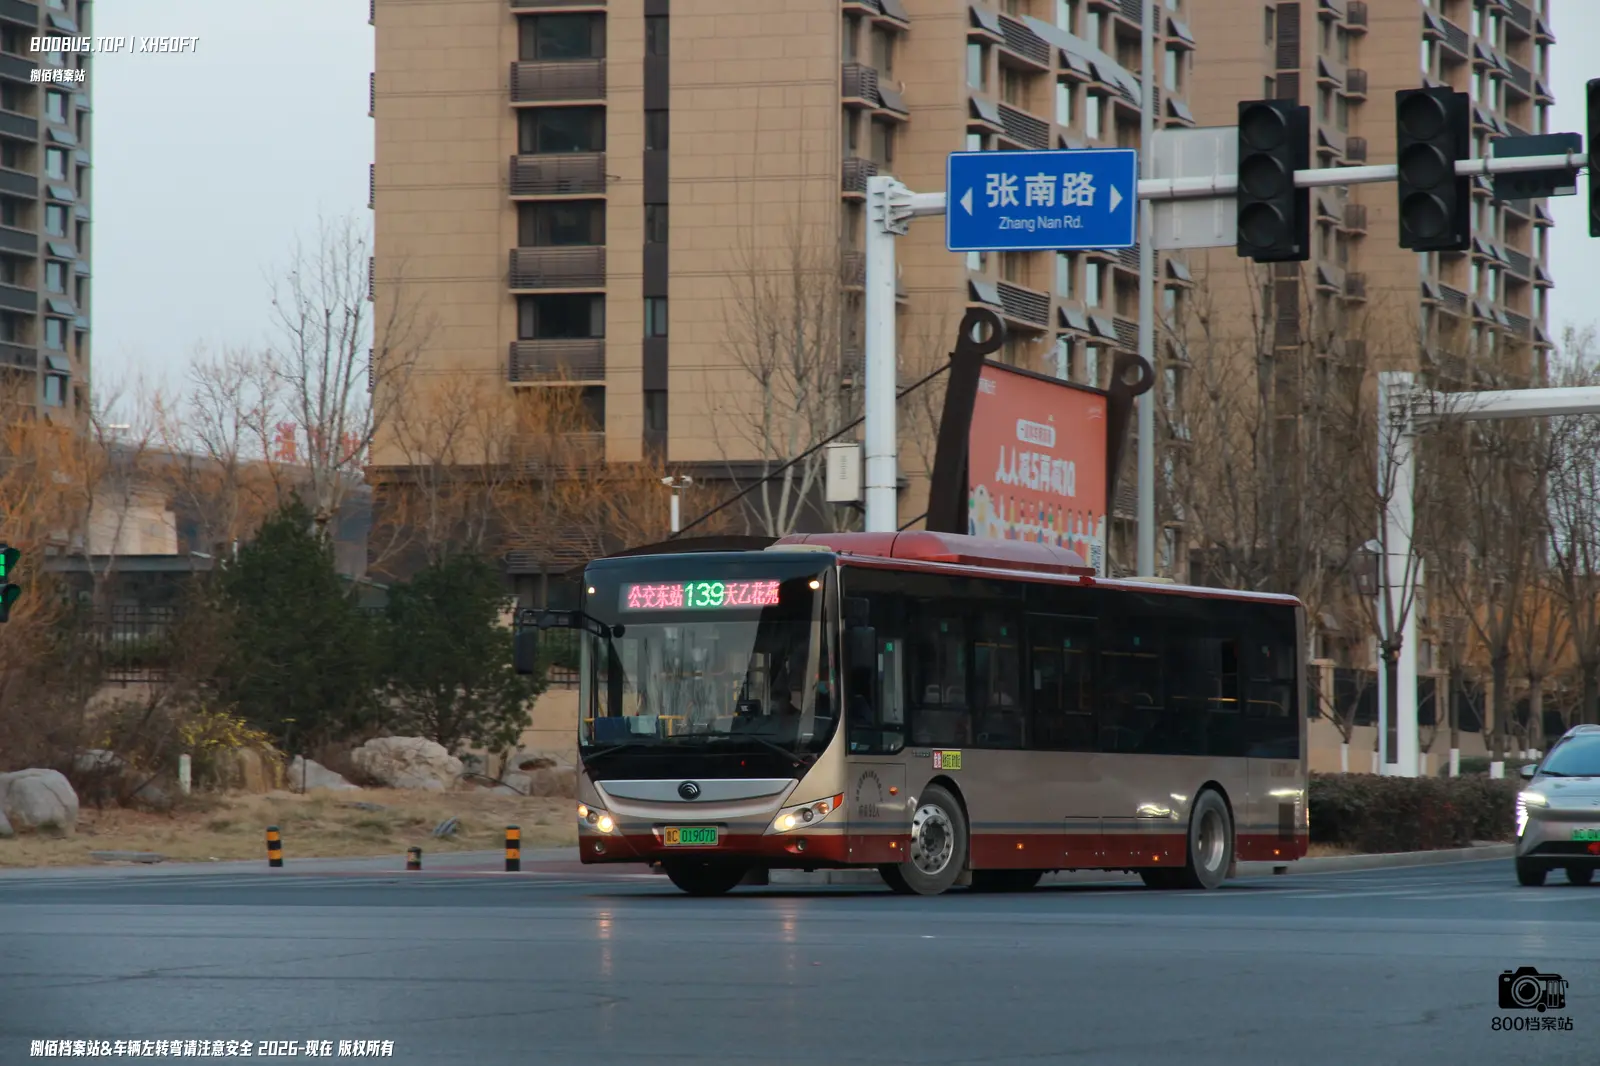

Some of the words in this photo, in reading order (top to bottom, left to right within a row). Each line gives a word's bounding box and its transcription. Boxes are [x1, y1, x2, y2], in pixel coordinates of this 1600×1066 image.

[985, 172, 1097, 208] 张南路
[998, 216, 1036, 232] Zhang
[1037, 215, 1062, 229] Nan
[1063, 215, 1084, 229] Rd.
[628, 584, 684, 608] 公交东站
[684, 582, 724, 607] 139
